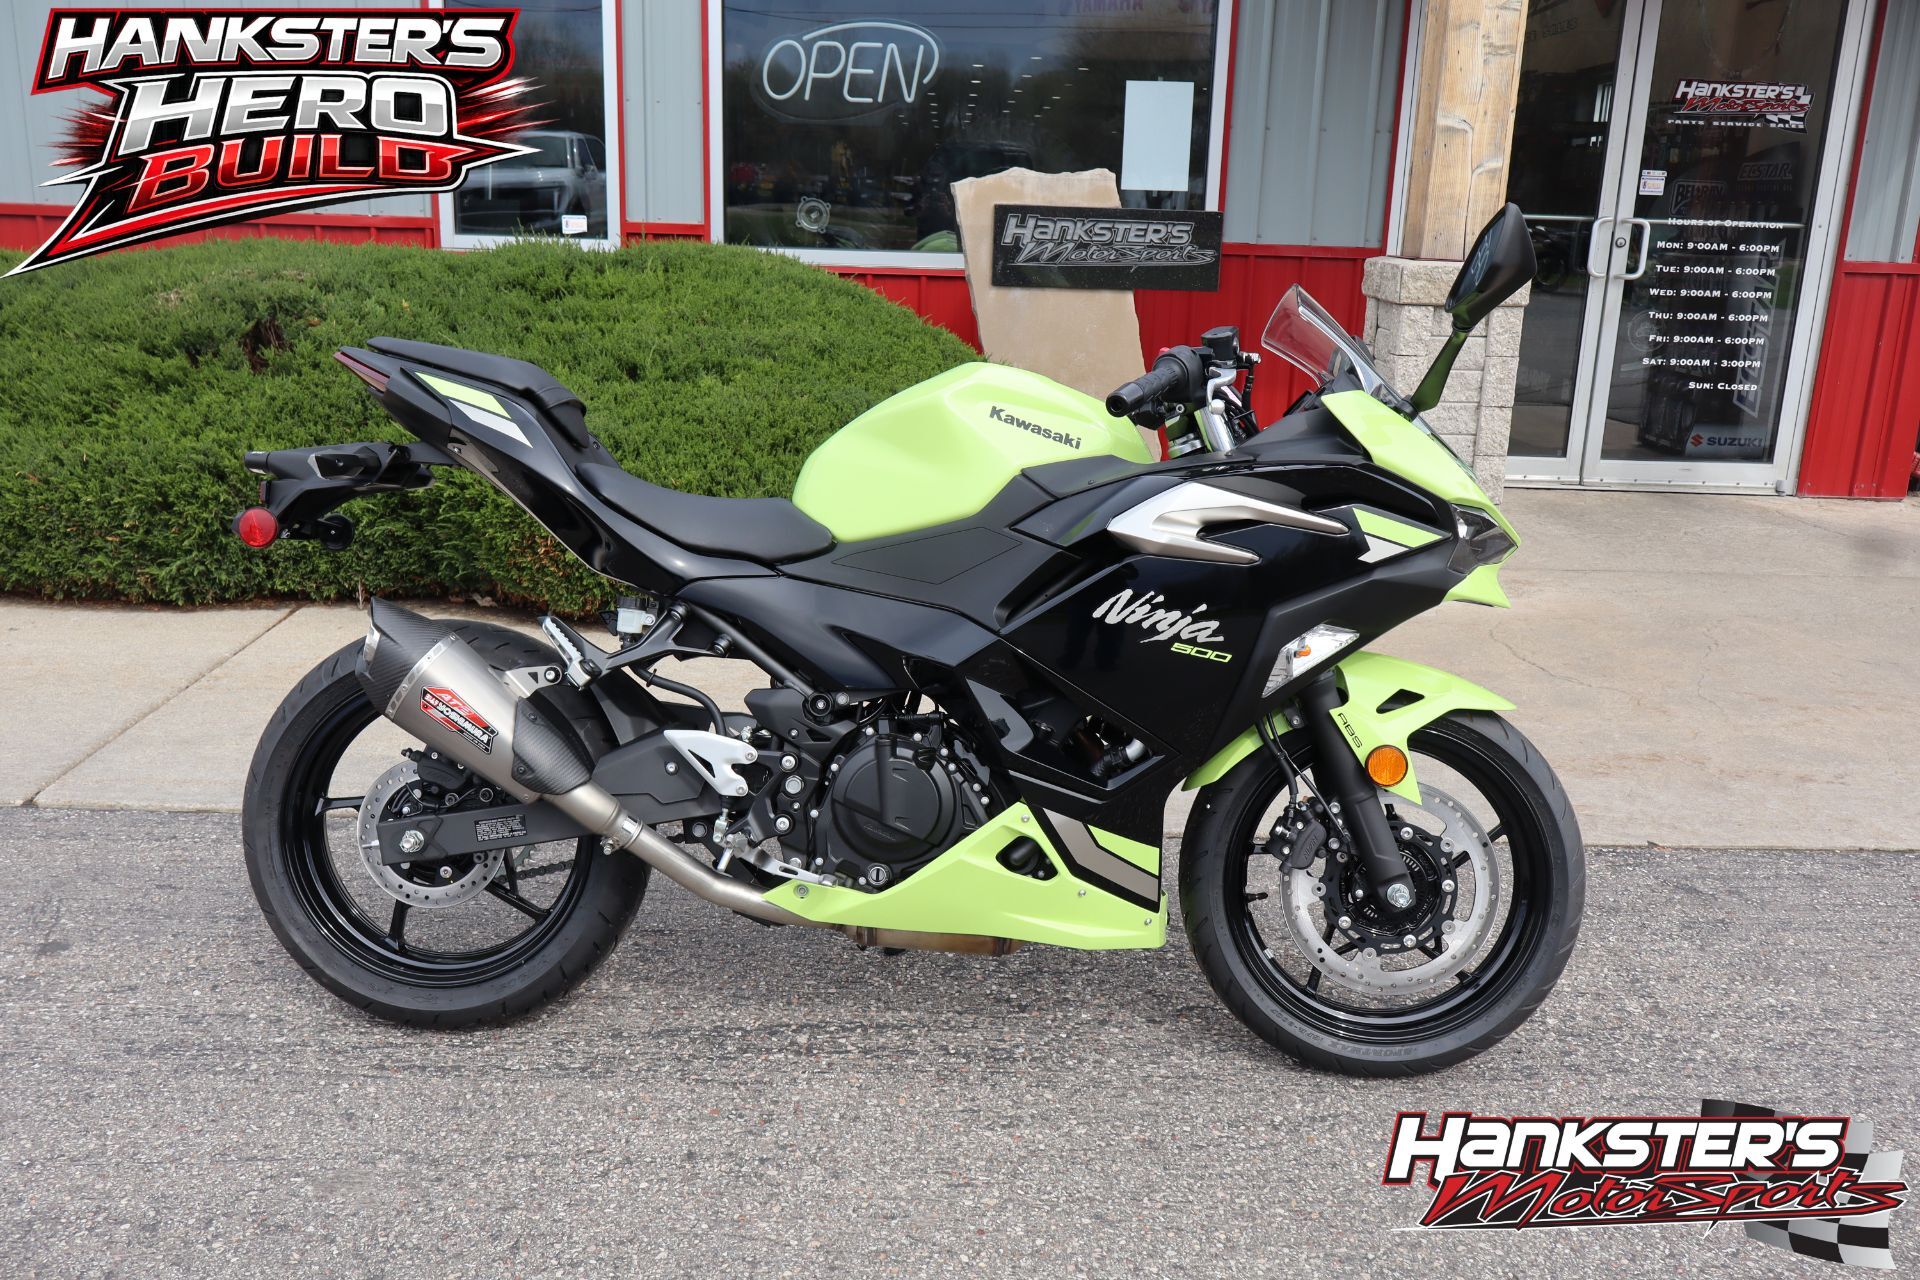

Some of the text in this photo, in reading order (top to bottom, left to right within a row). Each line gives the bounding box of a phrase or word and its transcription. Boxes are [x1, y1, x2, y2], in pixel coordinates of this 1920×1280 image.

[762, 39, 925, 104] OPEN
[1739, 243, 1780, 253] 6:00PM
[1683, 266, 1724, 274] 9:00AM
[1735, 267, 1776, 276] 6:00PM
[1680, 289, 1721, 298] 9:00AM
[1731, 290, 1772, 299] 6:00PM
[1676, 312, 1717, 321] 9:00AM
[1728, 313, 1769, 322] 6:00PM
[1673, 336, 1714, 344] 9:00AM
[1724, 337, 1765, 345] 6:00PM
[1669, 358, 1710, 367] 9:00AM
[1720, 360, 1761, 368] 3:00PM
[989, 405, 1082, 450] Kawasaki
[1706, 437, 1763, 448] SUZUKI
[1092, 588, 1225, 643] Ninja
[1170, 642, 1233, 663] 500
[1337, 712, 1363, 748] ABS
